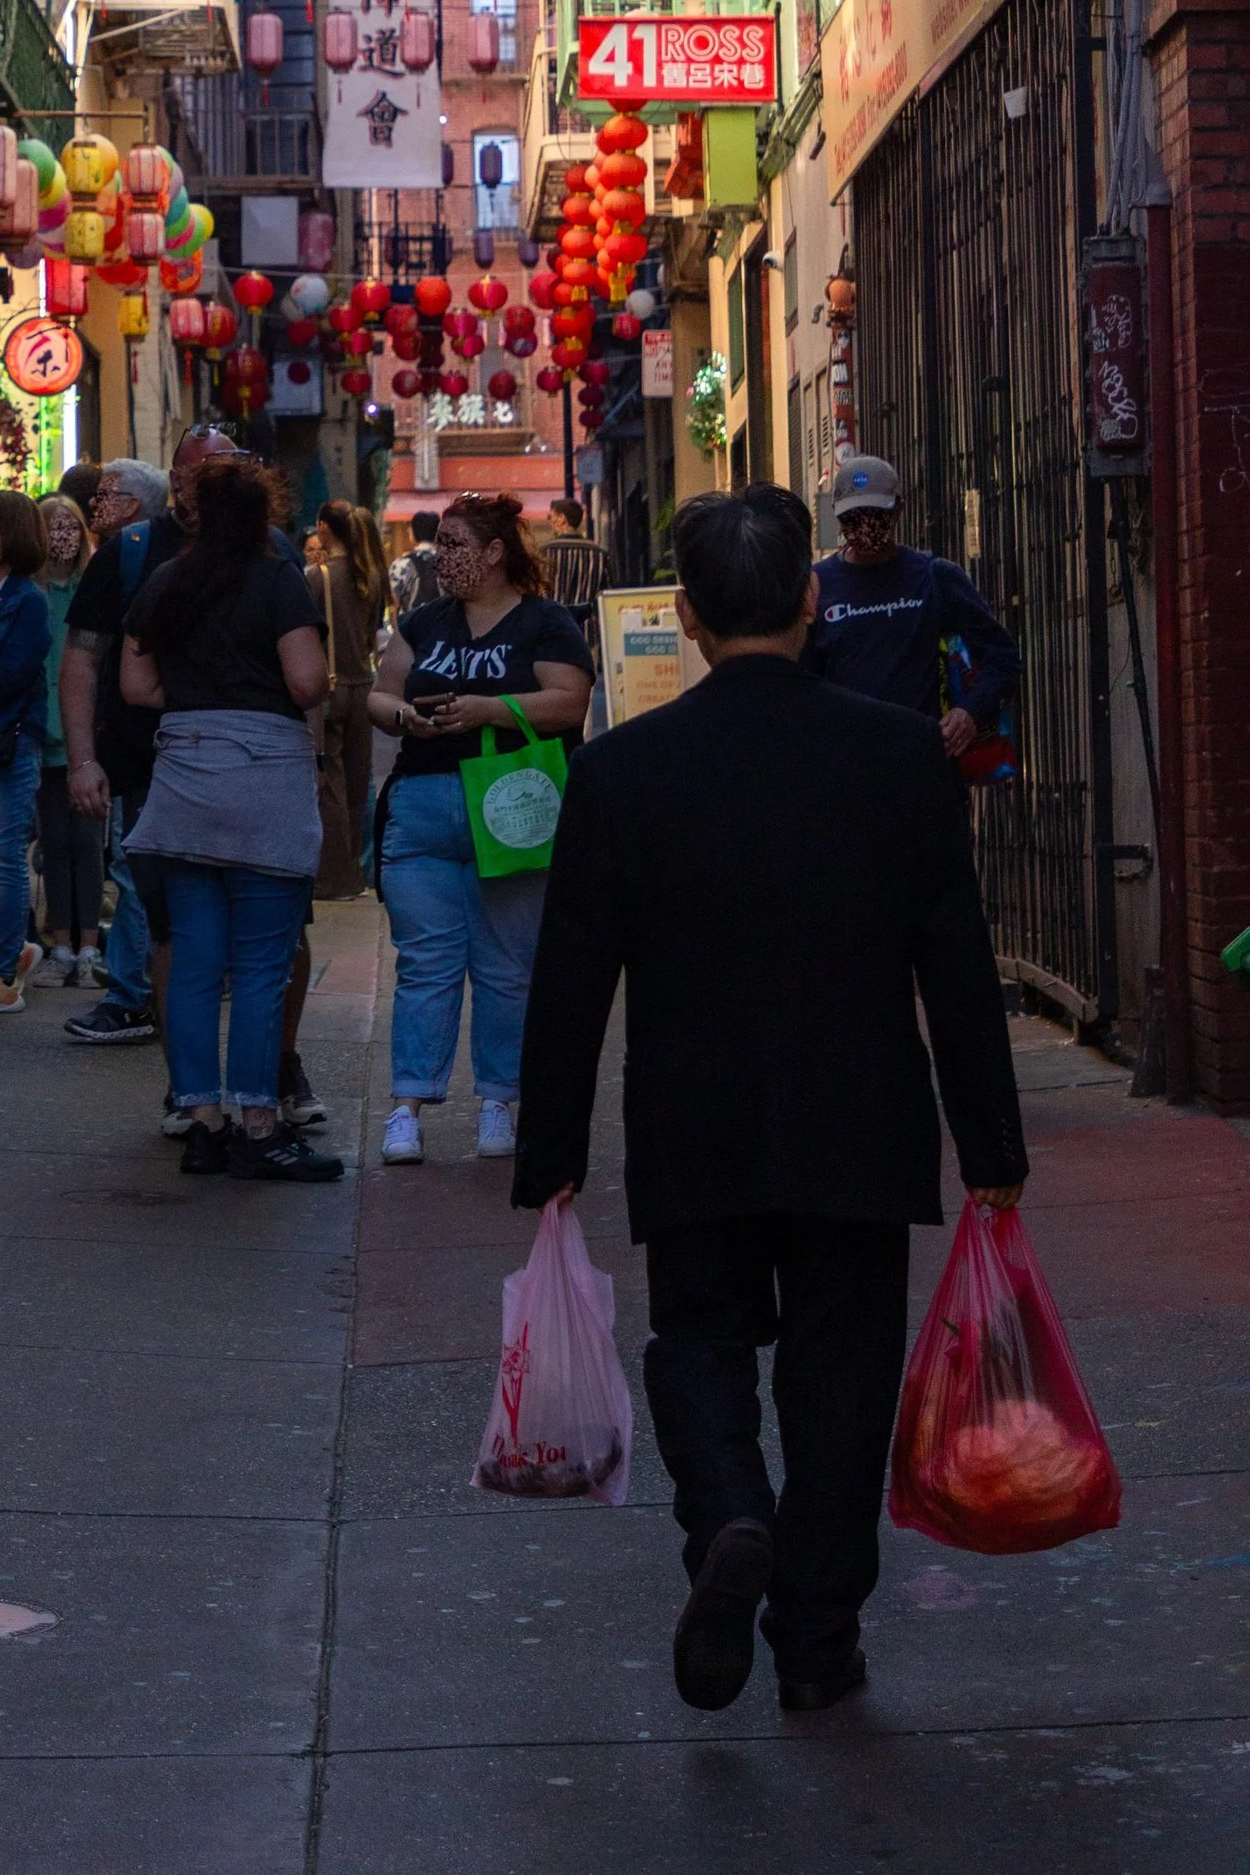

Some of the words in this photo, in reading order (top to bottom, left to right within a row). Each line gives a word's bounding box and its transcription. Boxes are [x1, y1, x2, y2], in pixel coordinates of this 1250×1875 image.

[588, 23, 657, 88] 41
[661, 24, 765, 62] ROSS
[824, 596, 924, 622] Champion
